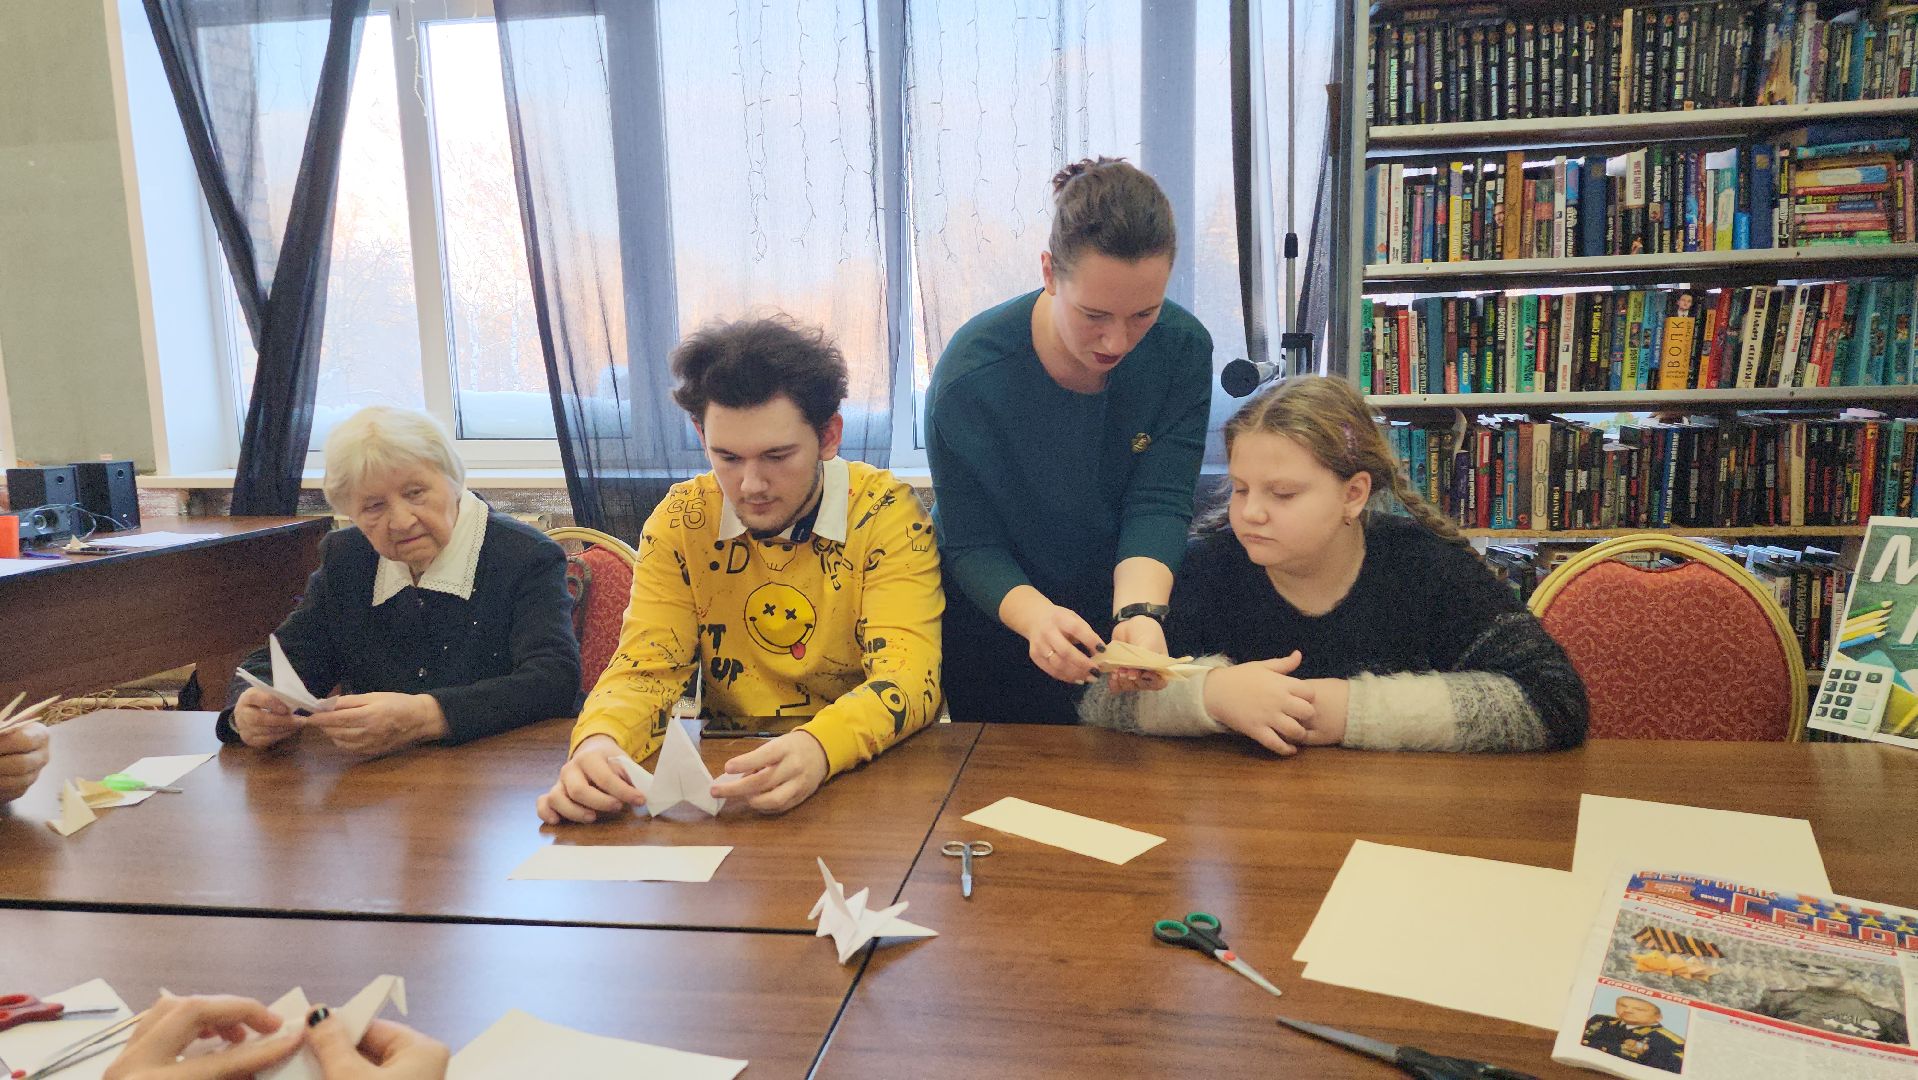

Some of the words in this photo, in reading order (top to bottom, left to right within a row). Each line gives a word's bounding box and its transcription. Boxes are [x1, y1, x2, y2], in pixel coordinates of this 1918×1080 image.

[1667, 320, 1685, 369] ВОЛК
[710, 656, 744, 690] UP
[1639, 870, 1778, 899] ВЕСТНИК
